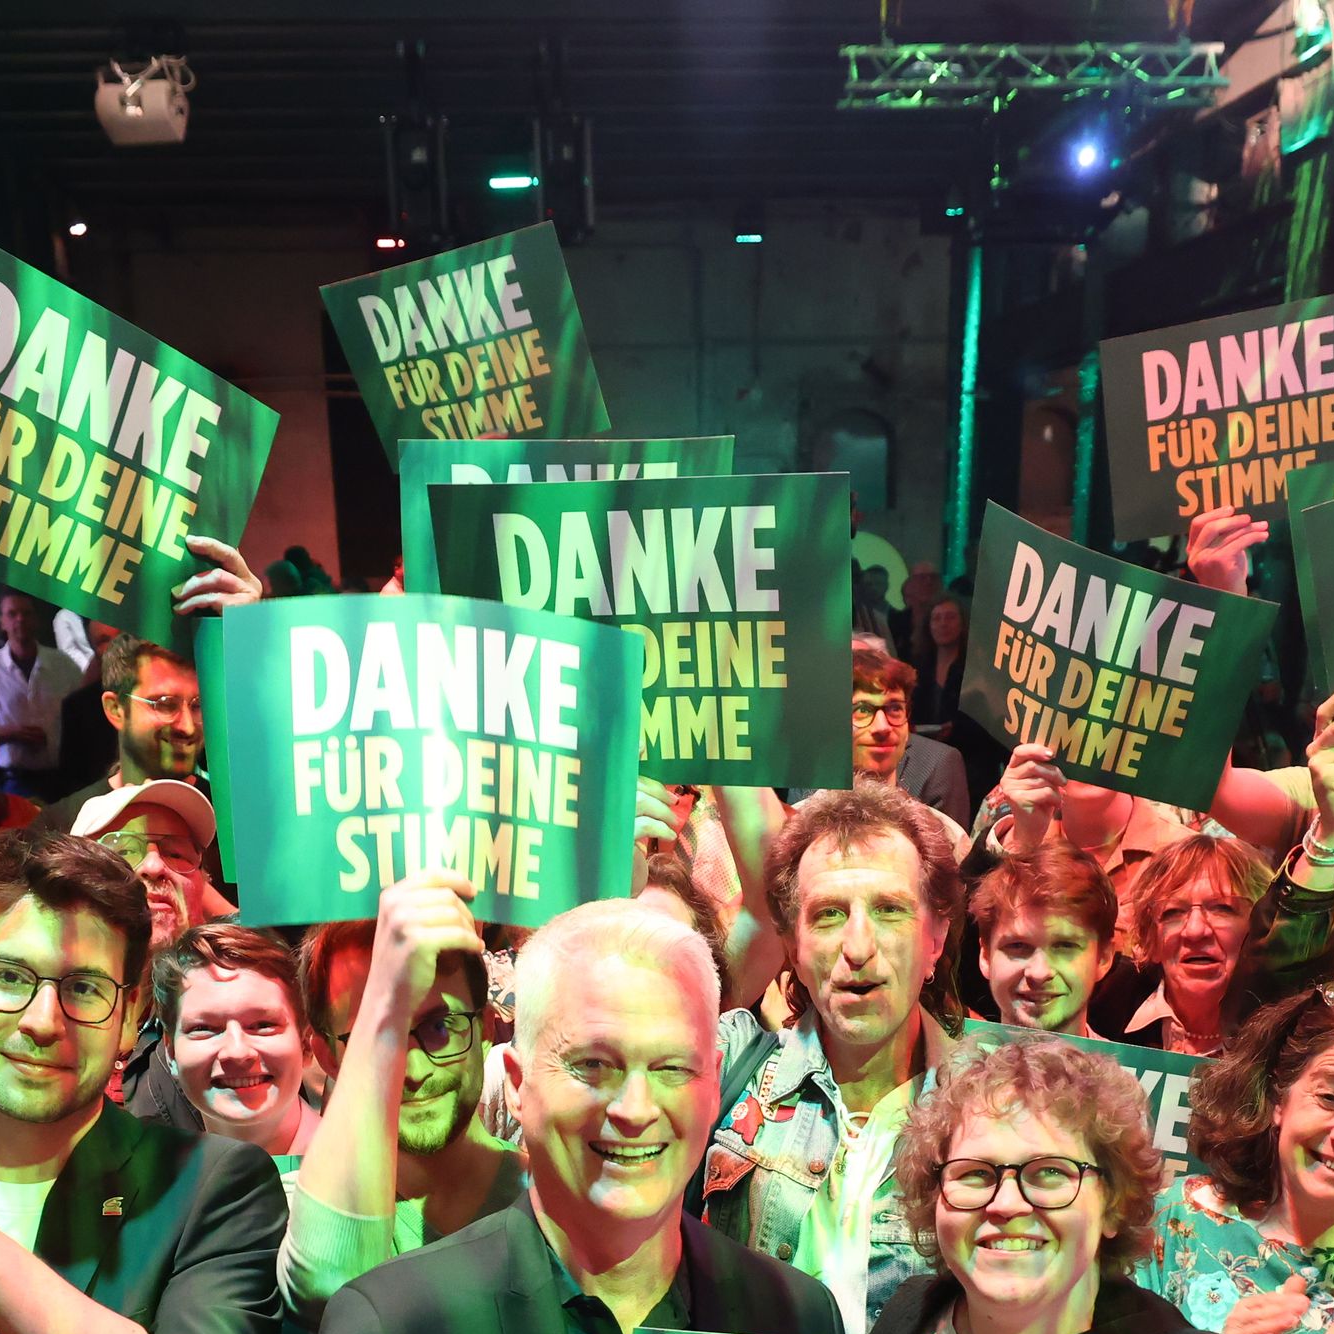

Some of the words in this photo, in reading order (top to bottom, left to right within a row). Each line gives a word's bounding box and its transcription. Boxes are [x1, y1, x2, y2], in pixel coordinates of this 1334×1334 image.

[358, 253, 531, 363] DANKE
[383, 359, 442, 410] FÜR
[447, 328, 550, 397] DEINE
[421, 384, 543, 440] STIMME
[1147, 418, 1217, 471] FÜR
[1176, 449, 1315, 518] STIMM
[45, 440, 199, 562] DEINE
[493, 504, 780, 616] DANKE
[1002, 541, 1215, 685] DANKE
[289, 622, 581, 751] DANKE
[993, 620, 1054, 694] FÜR
[1065, 659, 1195, 738] DEINE
[1002, 689, 1150, 779] STIMME
[293, 735, 405, 816] FÜR
[422, 735, 581, 828] DEINE
[334, 812, 543, 899] STIMME
